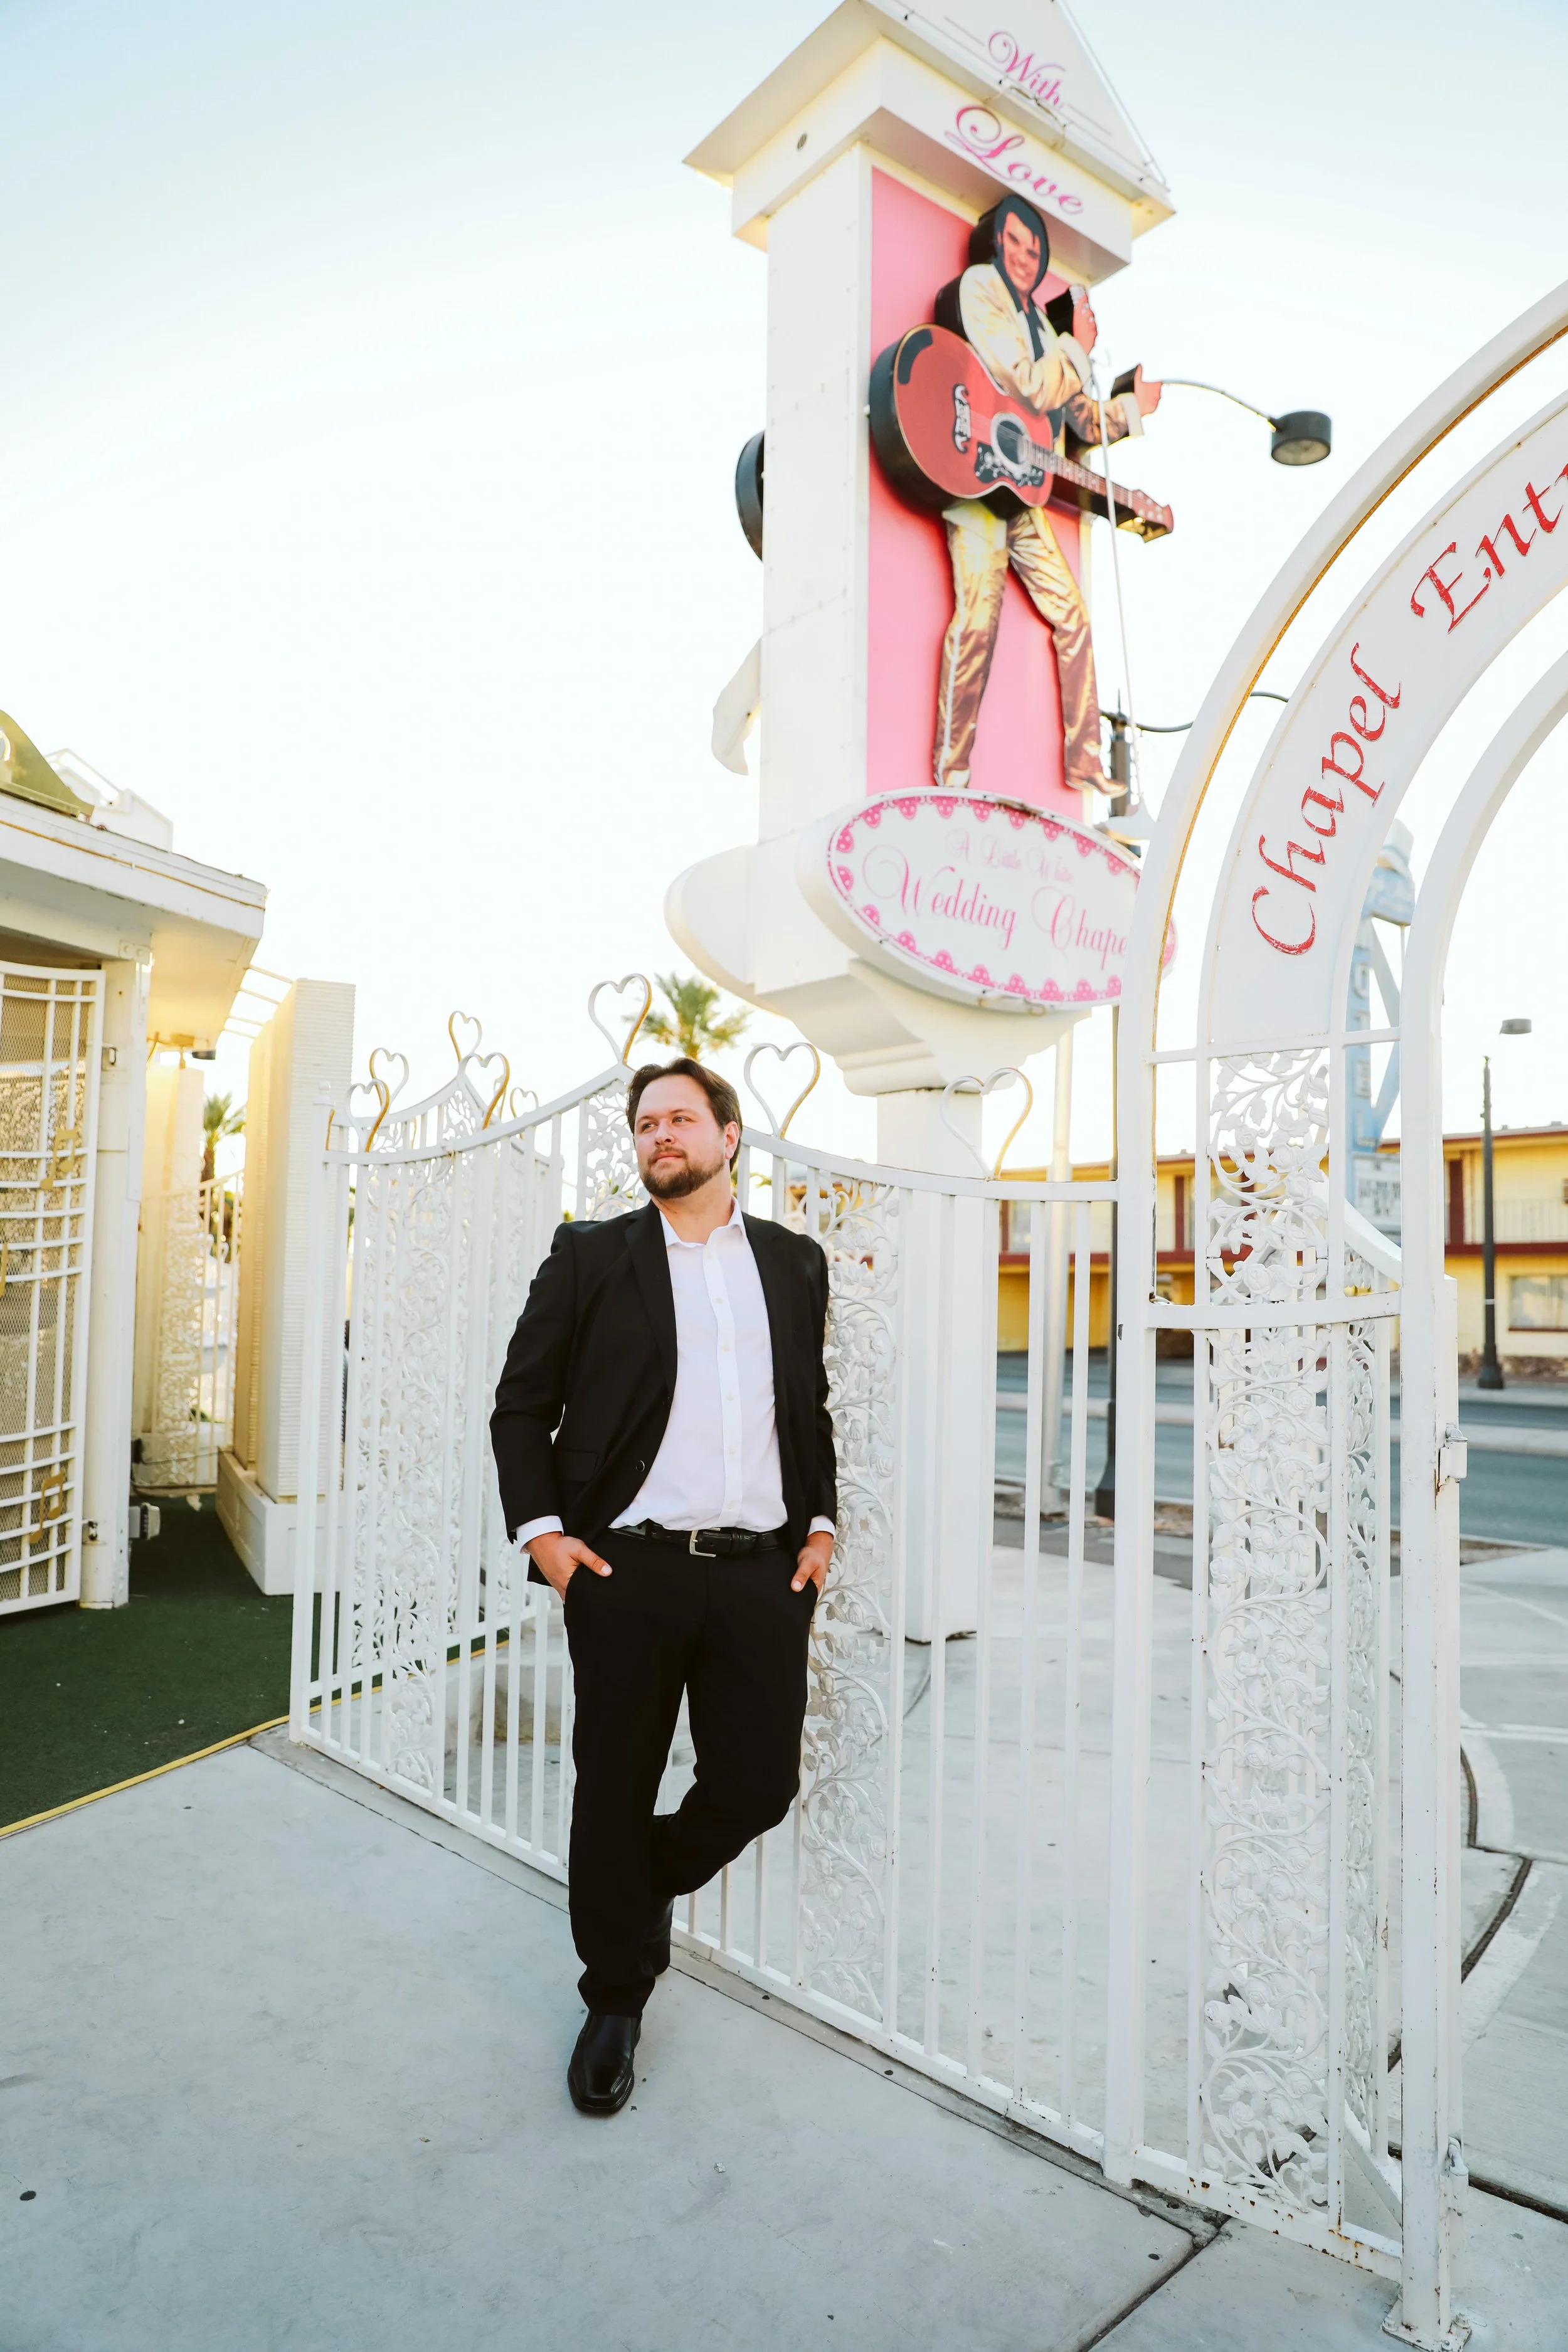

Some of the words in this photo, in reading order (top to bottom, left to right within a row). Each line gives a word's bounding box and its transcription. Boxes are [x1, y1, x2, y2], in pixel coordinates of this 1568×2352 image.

[988, 31, 1066, 109] With
[945, 106, 1083, 215] Love
[1251, 641, 1403, 956] Chapel
[1409, 463, 1568, 635] Ent
[862, 844, 1017, 951] Wedding
[1030, 885, 1128, 971] Chape
